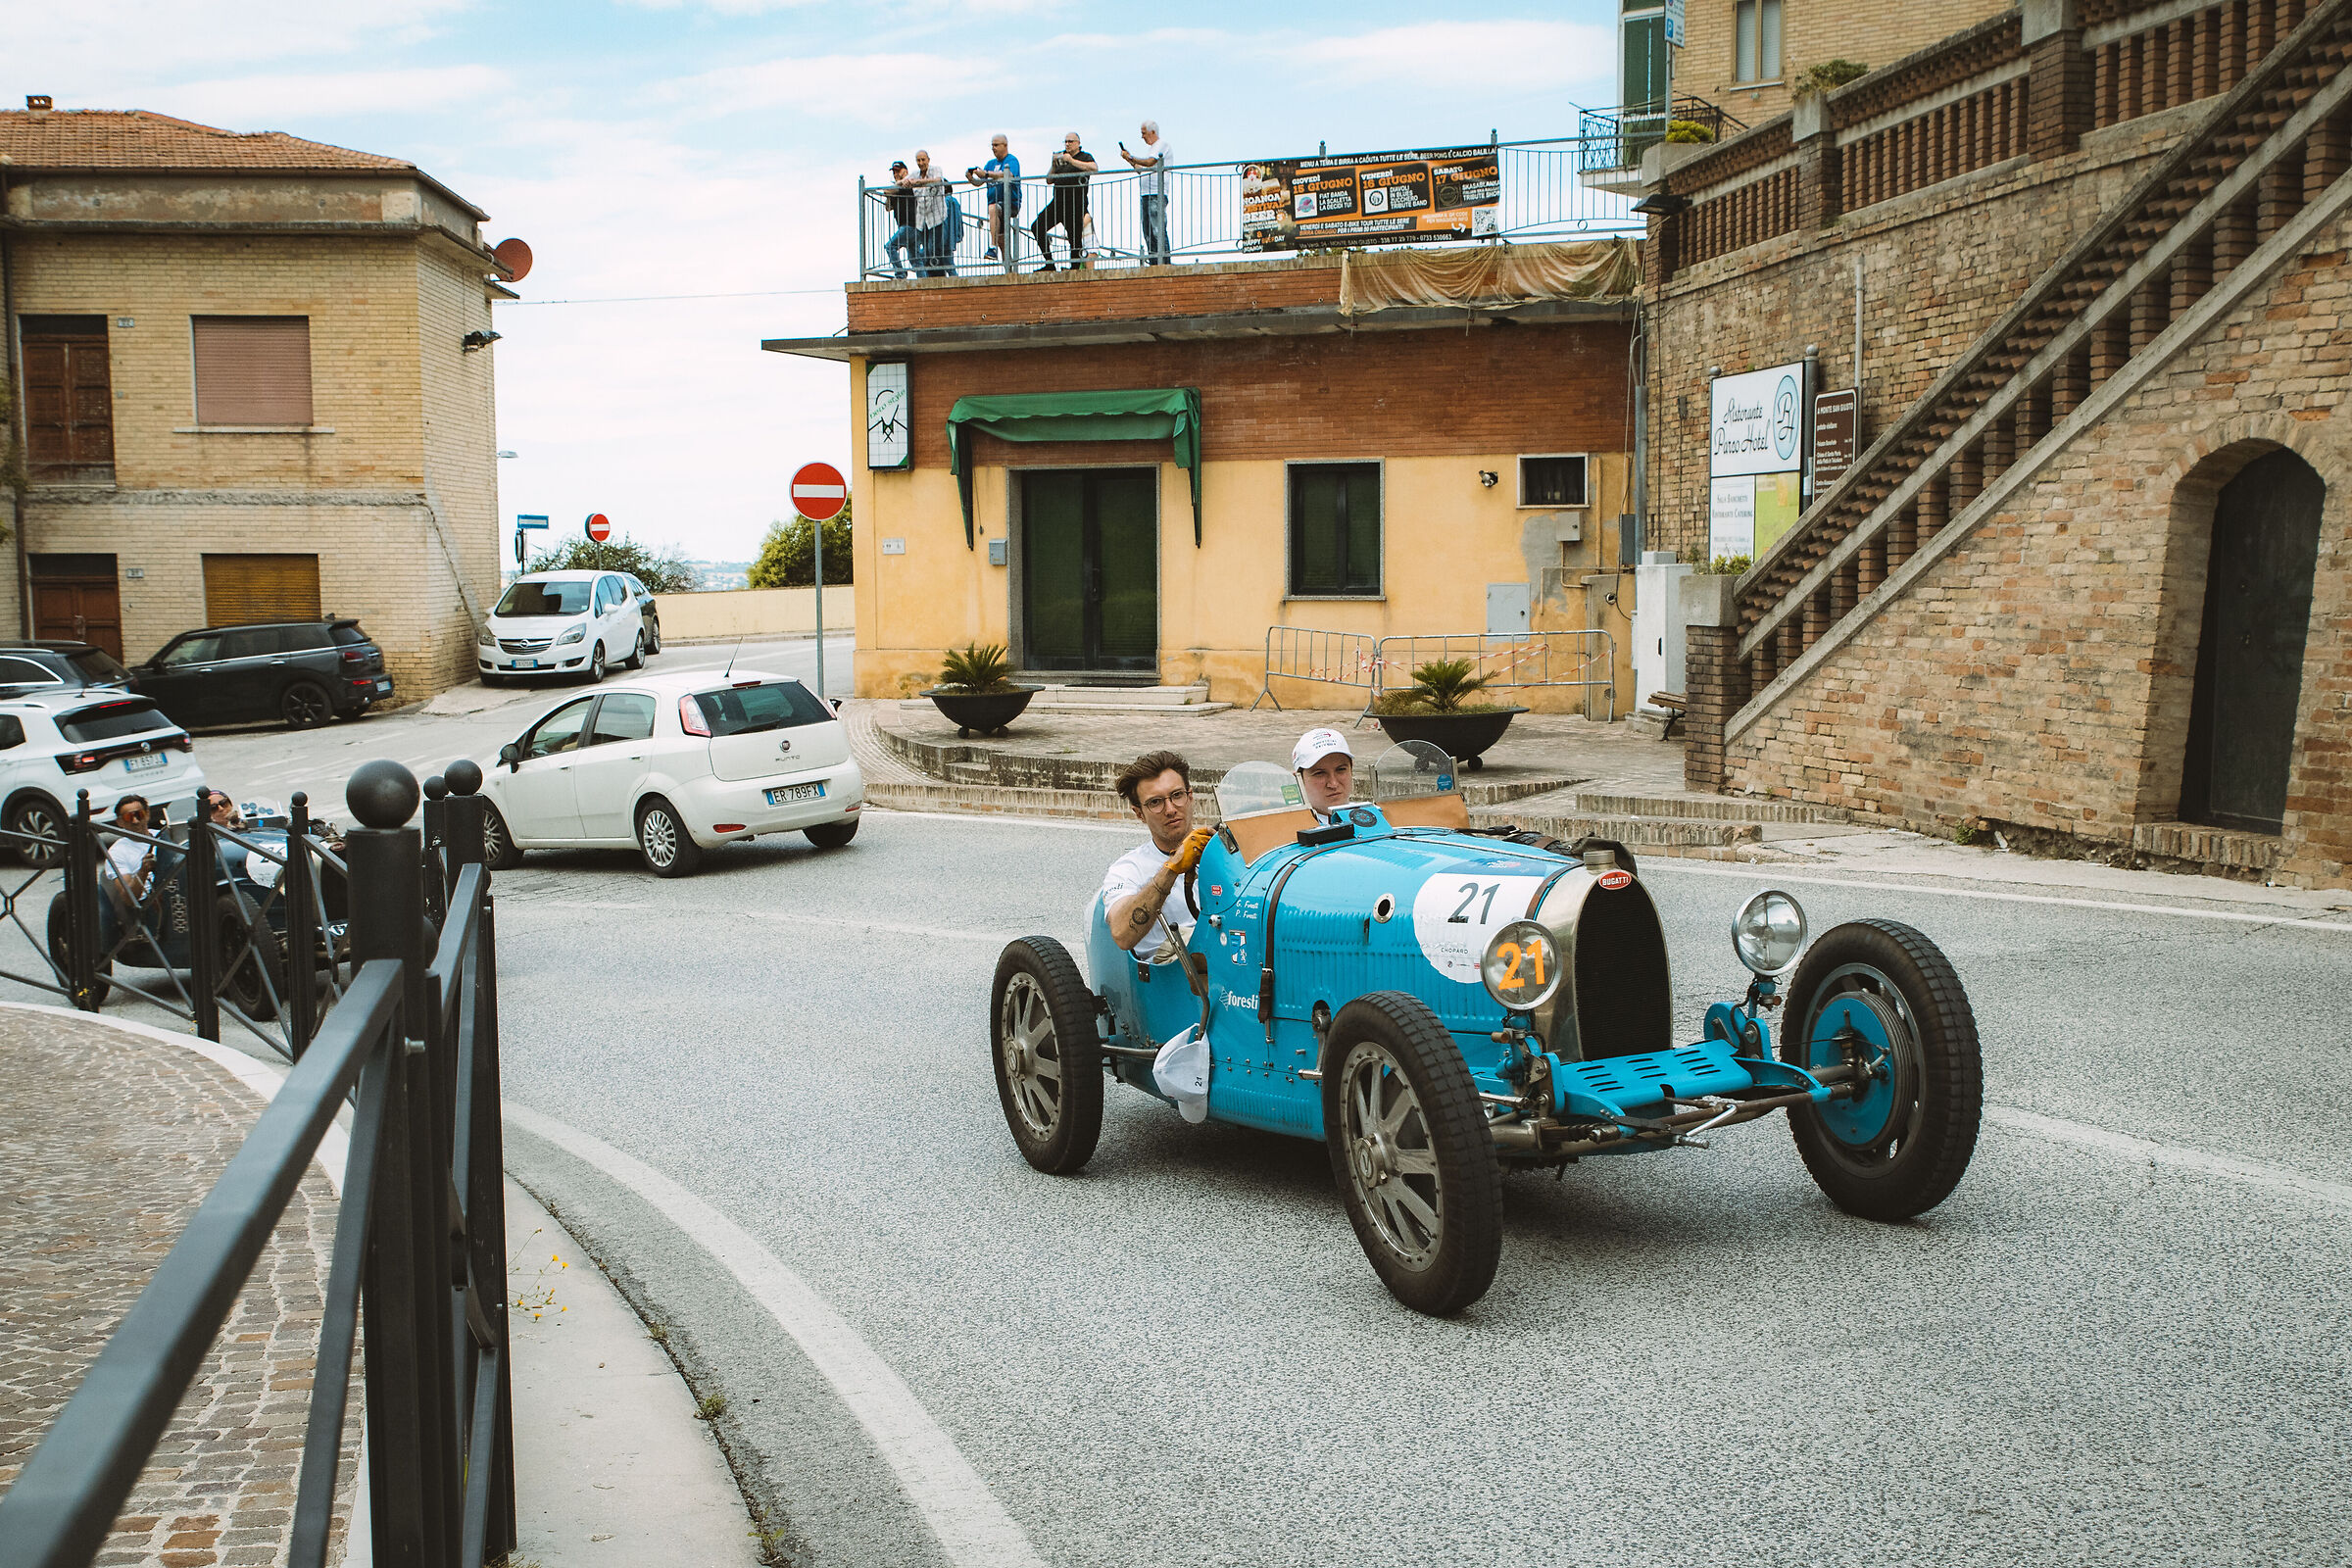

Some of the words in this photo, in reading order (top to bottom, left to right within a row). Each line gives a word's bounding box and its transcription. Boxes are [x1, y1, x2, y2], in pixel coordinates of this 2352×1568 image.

[1473, 147, 1496, 156] BALILLA
[1361, 170, 1393, 180] VENERDÌ
[1434, 167, 1463, 175] SABATO
[1436, 174, 1446, 184] 17
[1450, 166, 1497, 181] GIUGNO
[1294, 184, 1304, 193] 15
[1308, 177, 1352, 191] GIUGNO
[1363, 179, 1375, 189] 16
[1378, 172, 1425, 186] GIUGNO
[1244, 209, 1276, 222] BEER
[1724, 397, 1762, 425] Ristorante
[1714, 427, 1740, 455] Parco
[1741, 419, 1770, 453] Hotel
[773, 790, 787, 803] ER
[789, 785, 819, 800] 789FX
[1602, 876, 1629, 886] BUGATTI
[1447, 882, 1500, 925] 21
[1496, 939, 1545, 991] 21
[1228, 990, 1258, 1009] foresti
[1195, 1076, 1202, 1087] 21
